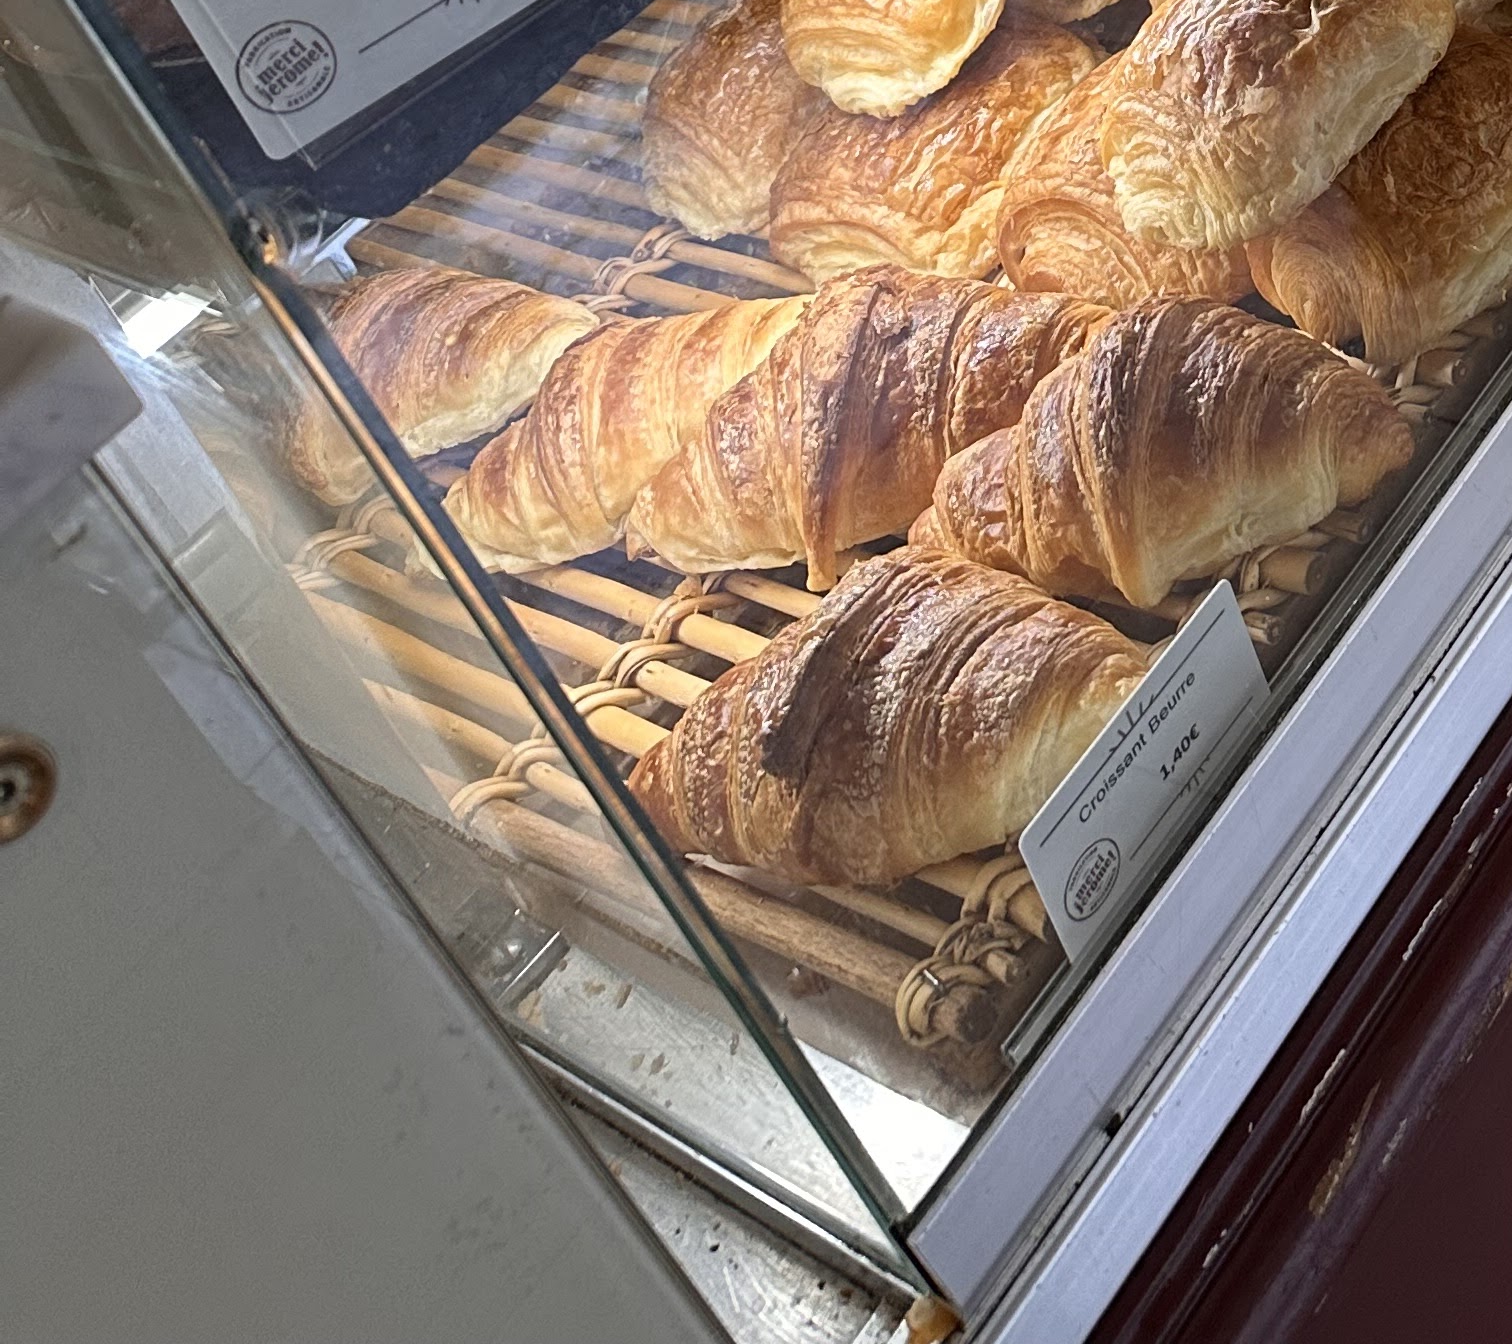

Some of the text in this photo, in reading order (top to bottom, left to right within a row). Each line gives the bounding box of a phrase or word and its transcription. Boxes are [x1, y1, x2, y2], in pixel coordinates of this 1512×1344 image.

[254, 40, 330, 106] jerome!
[257, 38, 307, 85] merci
[1078, 732, 1148, 824] Croissant
[1148, 670, 1197, 735] Beurre
[1157, 724, 1201, 782] 1,40€
[1075, 853, 1105, 900] merci
